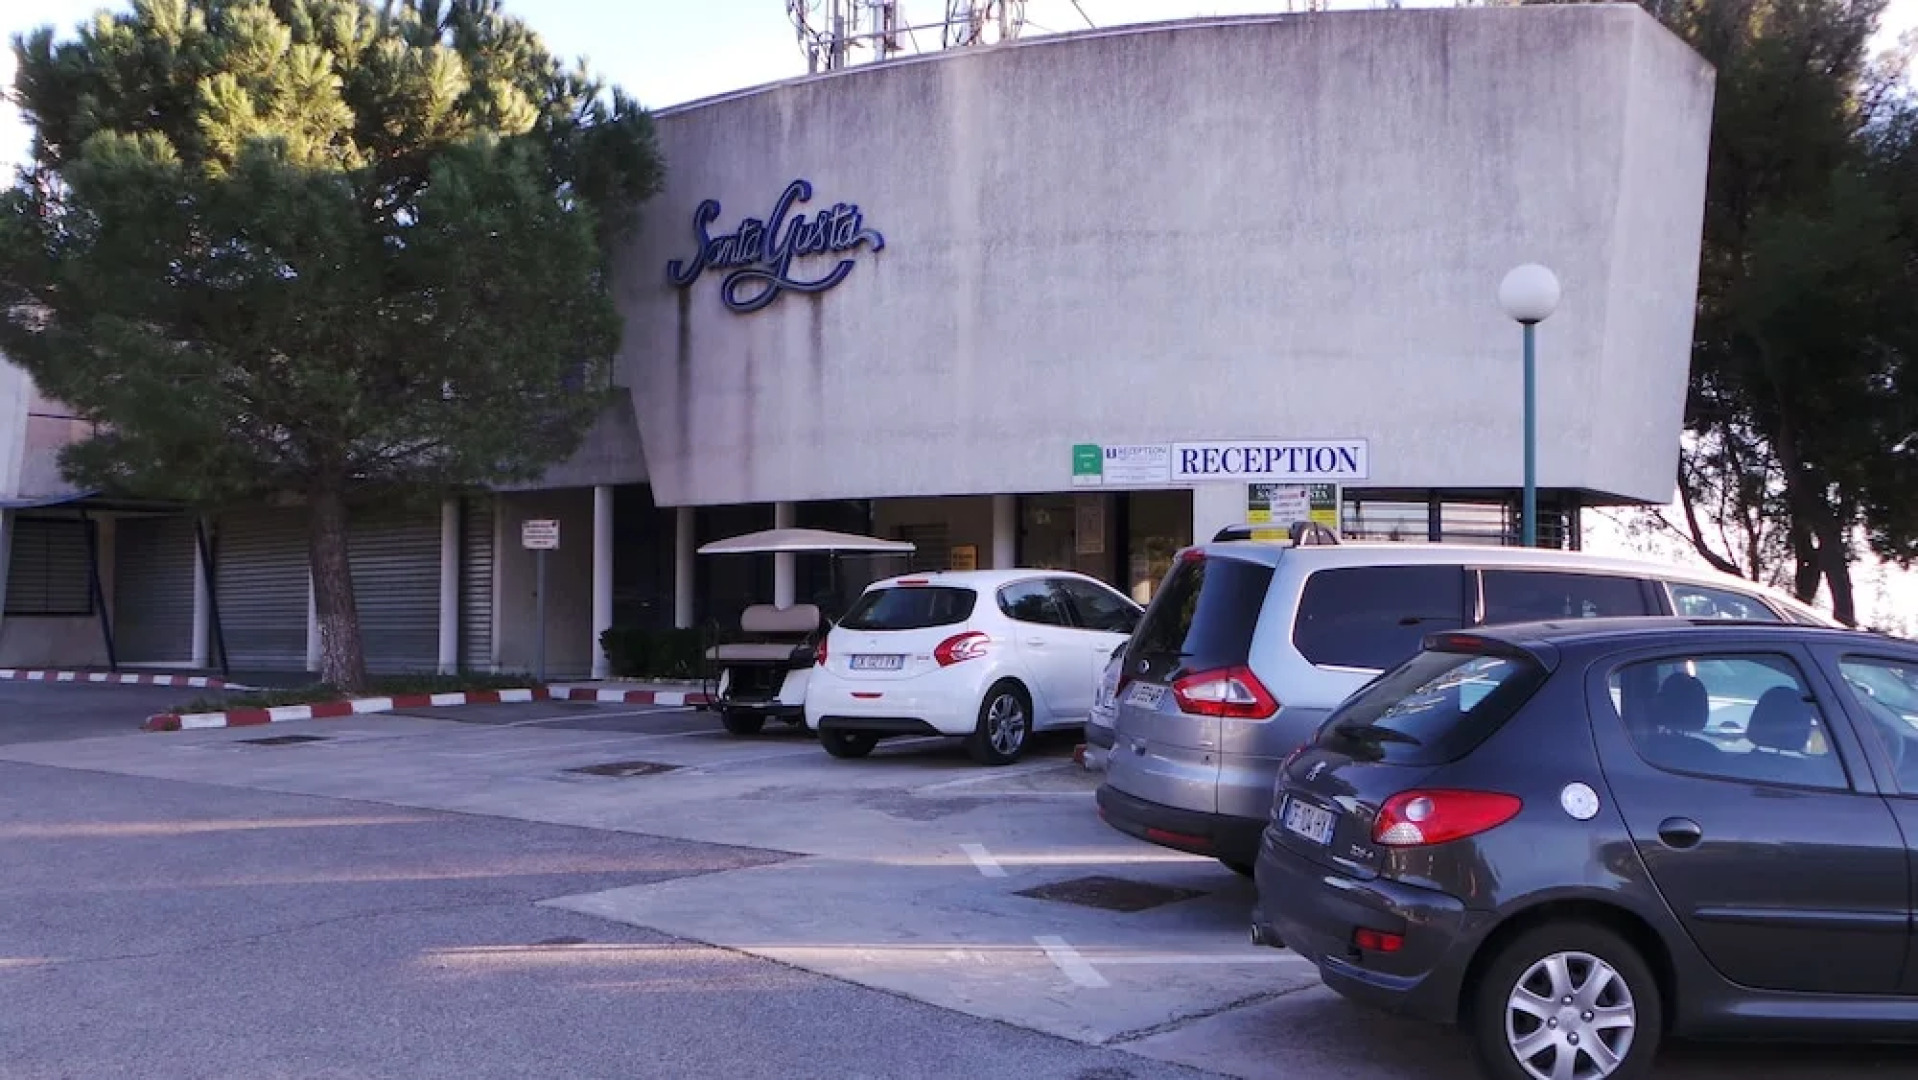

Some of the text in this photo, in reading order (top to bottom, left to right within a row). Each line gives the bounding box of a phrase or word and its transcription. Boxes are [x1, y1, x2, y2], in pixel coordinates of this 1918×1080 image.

[667, 178, 885, 312] Santa Gusta
[1179, 446, 1359, 475] RECEPTION
